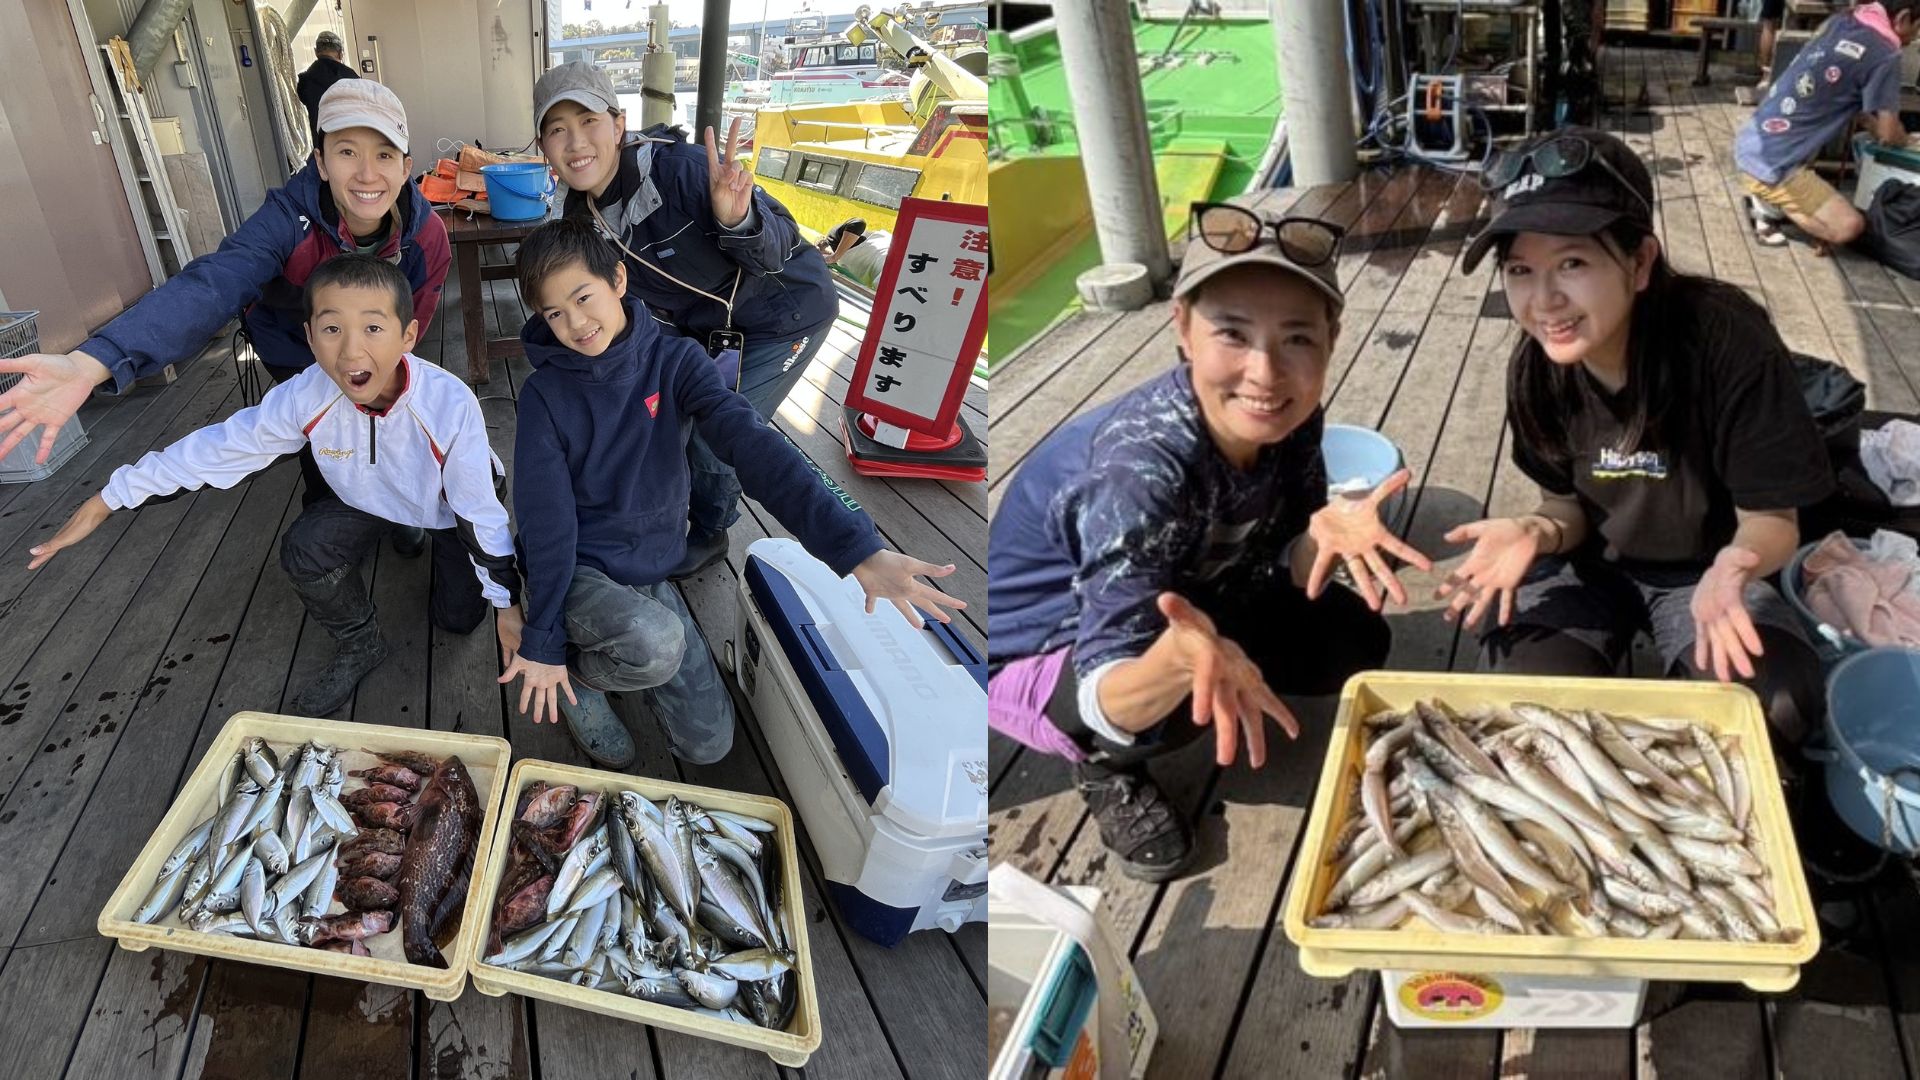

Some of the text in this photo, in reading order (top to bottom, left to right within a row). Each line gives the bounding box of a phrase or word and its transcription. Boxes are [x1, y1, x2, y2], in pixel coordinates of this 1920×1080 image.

[783, 336, 810, 372] ellesse
[875, 252, 939, 393] すべります
